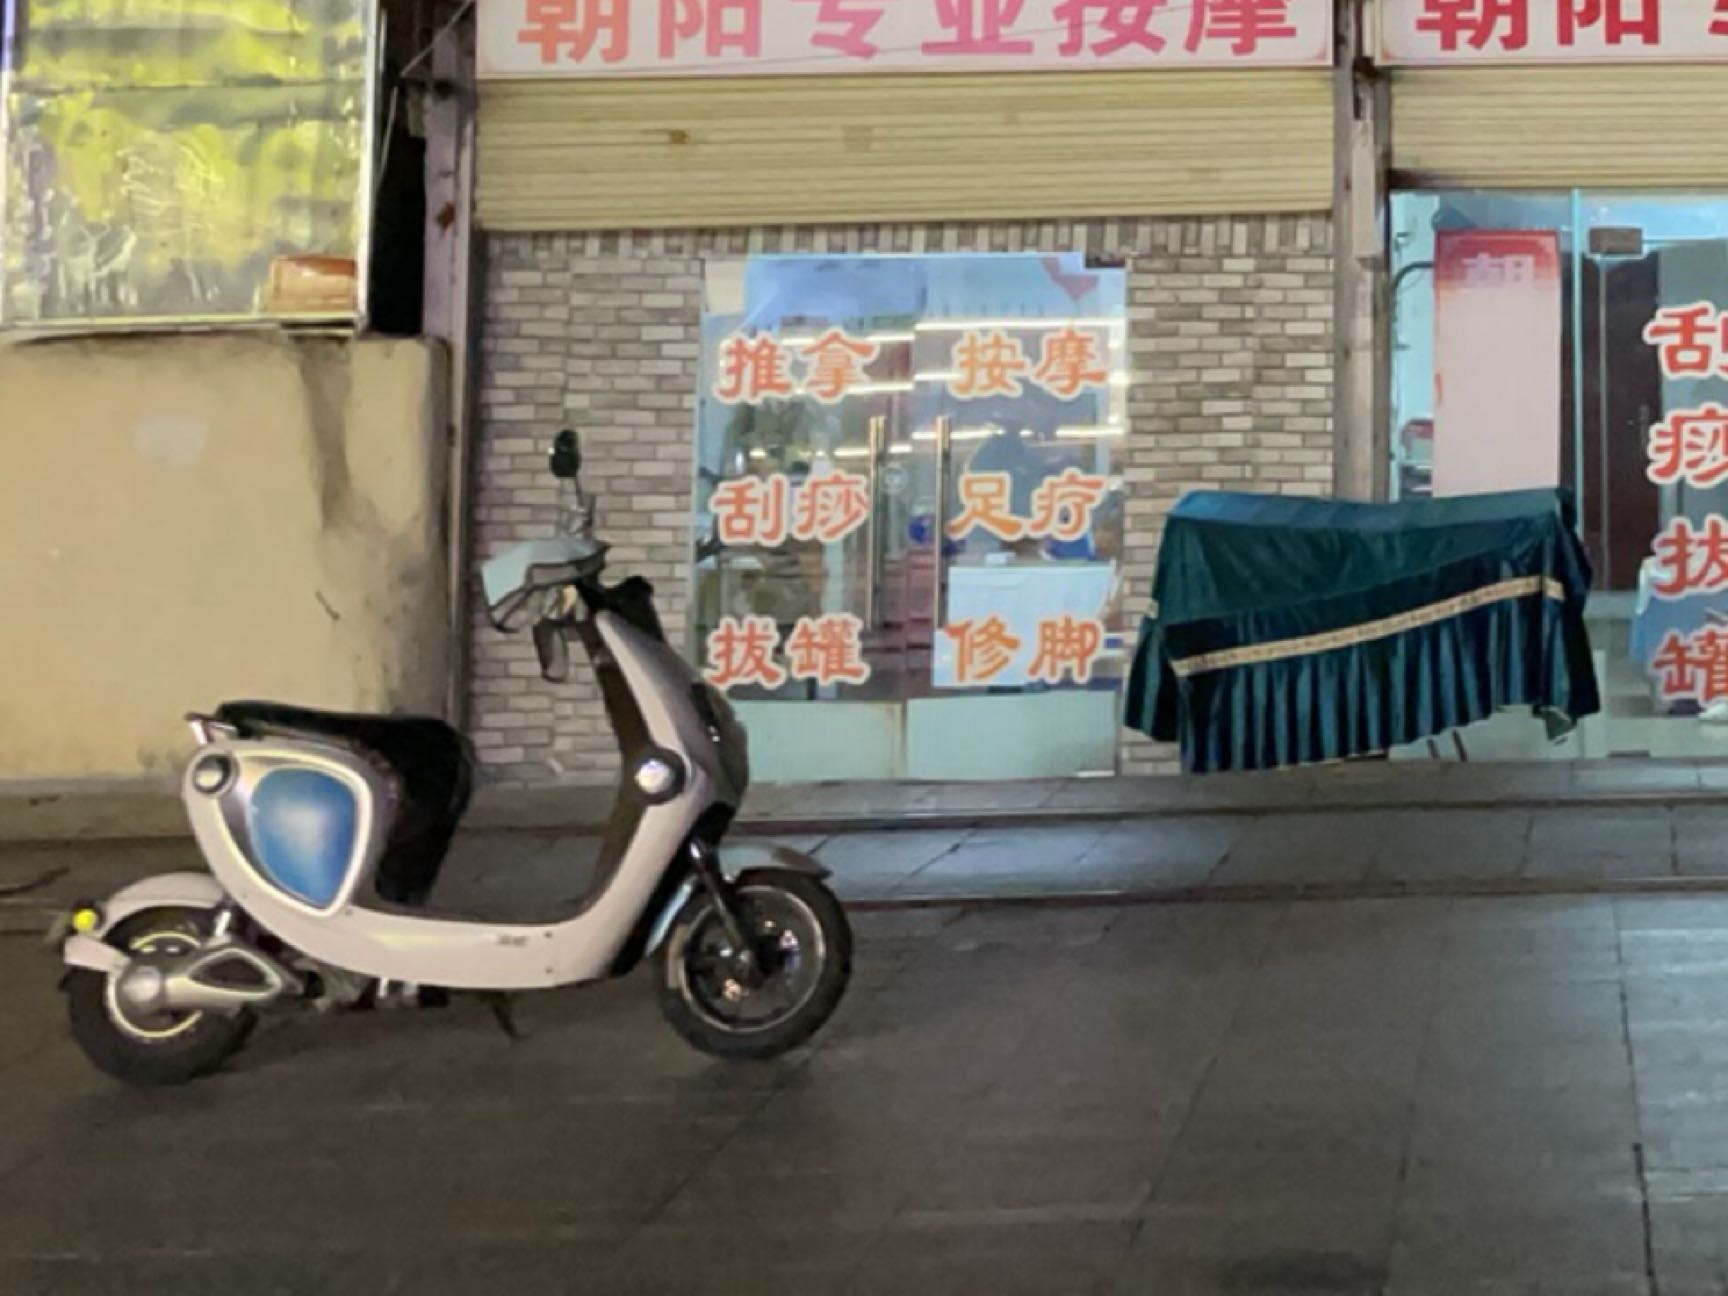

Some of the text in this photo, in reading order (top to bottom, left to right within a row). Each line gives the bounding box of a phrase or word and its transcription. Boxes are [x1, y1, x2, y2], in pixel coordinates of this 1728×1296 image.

[714, 330, 876, 401] 推拿
[950, 326, 1110, 397] 按摩
[711, 468, 872, 546] 刮痧
[946, 468, 1109, 541] 足疗
[705, 613, 870, 688] 拔罐
[946, 613, 1104, 683] 修脚
